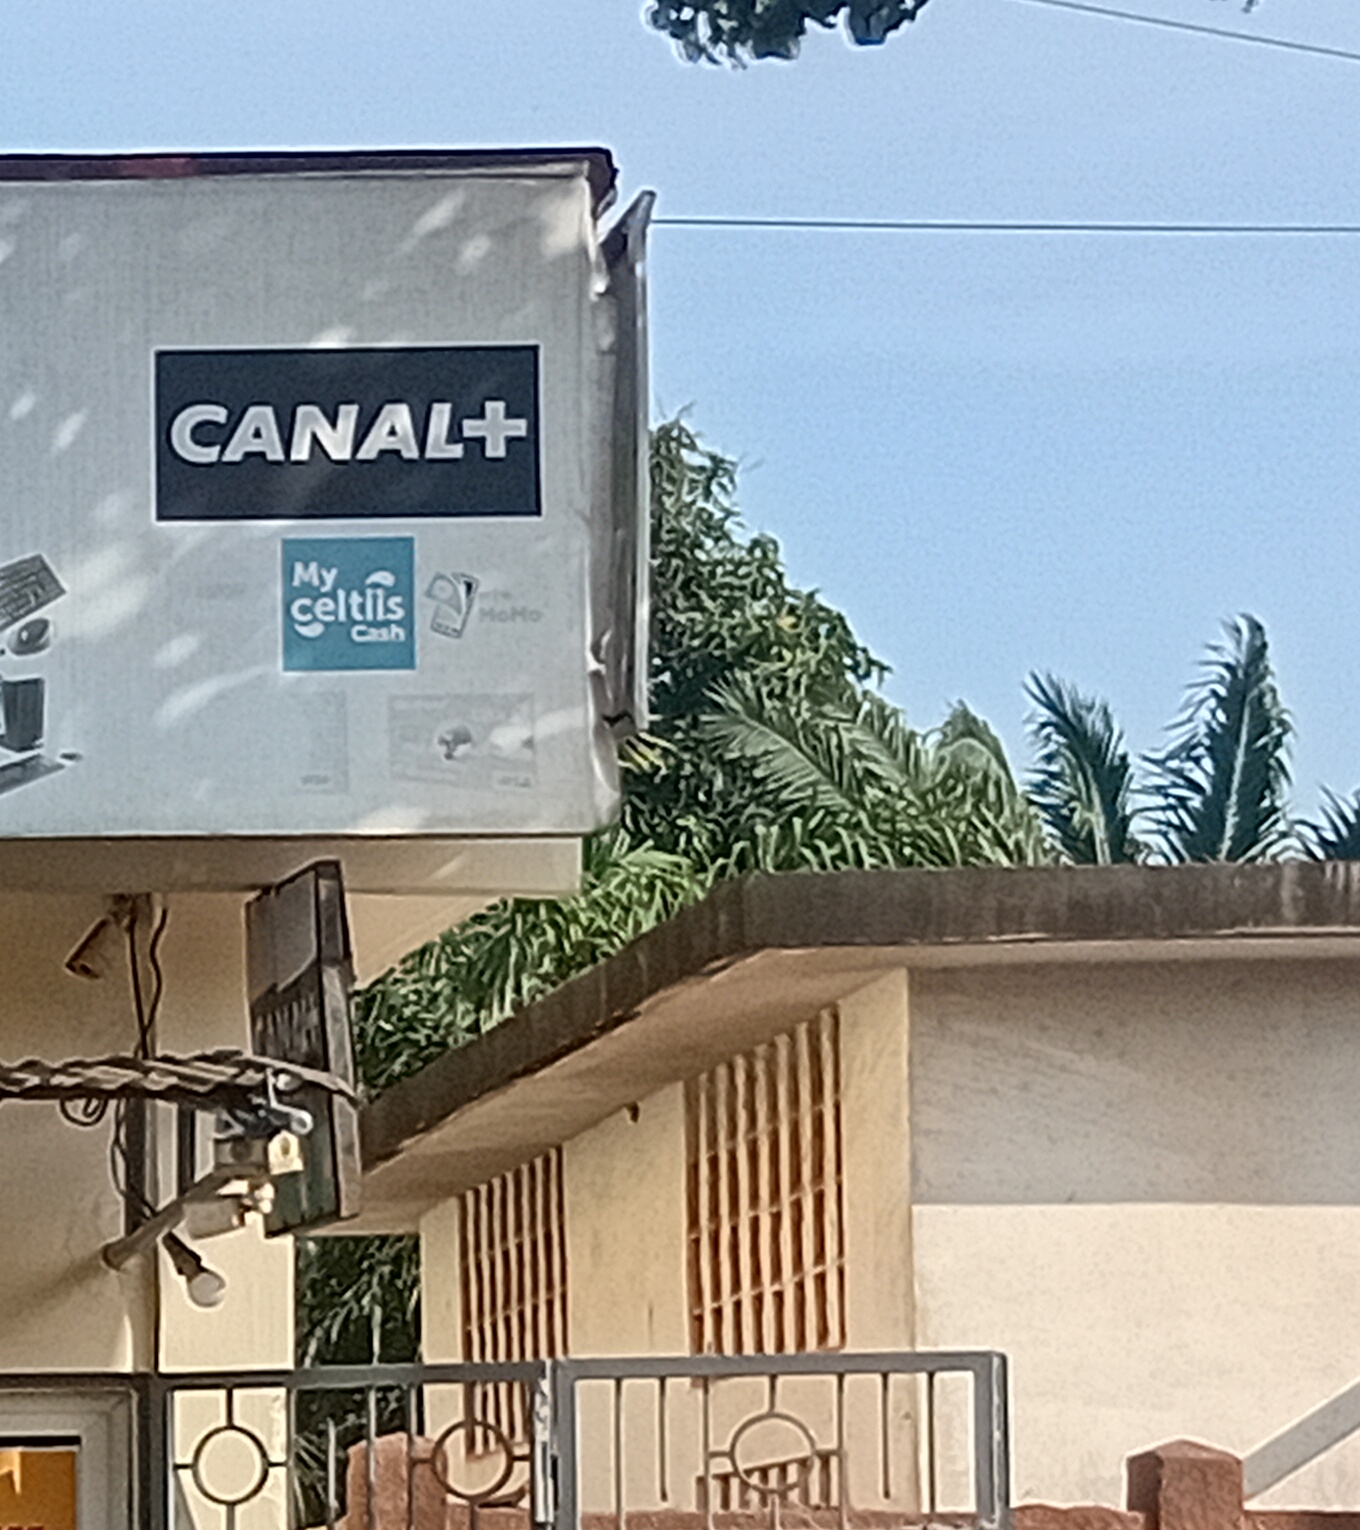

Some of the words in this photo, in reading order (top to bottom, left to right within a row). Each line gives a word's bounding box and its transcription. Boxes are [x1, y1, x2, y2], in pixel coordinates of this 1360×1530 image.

[170, 401, 528, 464] CANAL+
[292, 561, 338, 592] My
[350, 624, 406, 642] Cash
